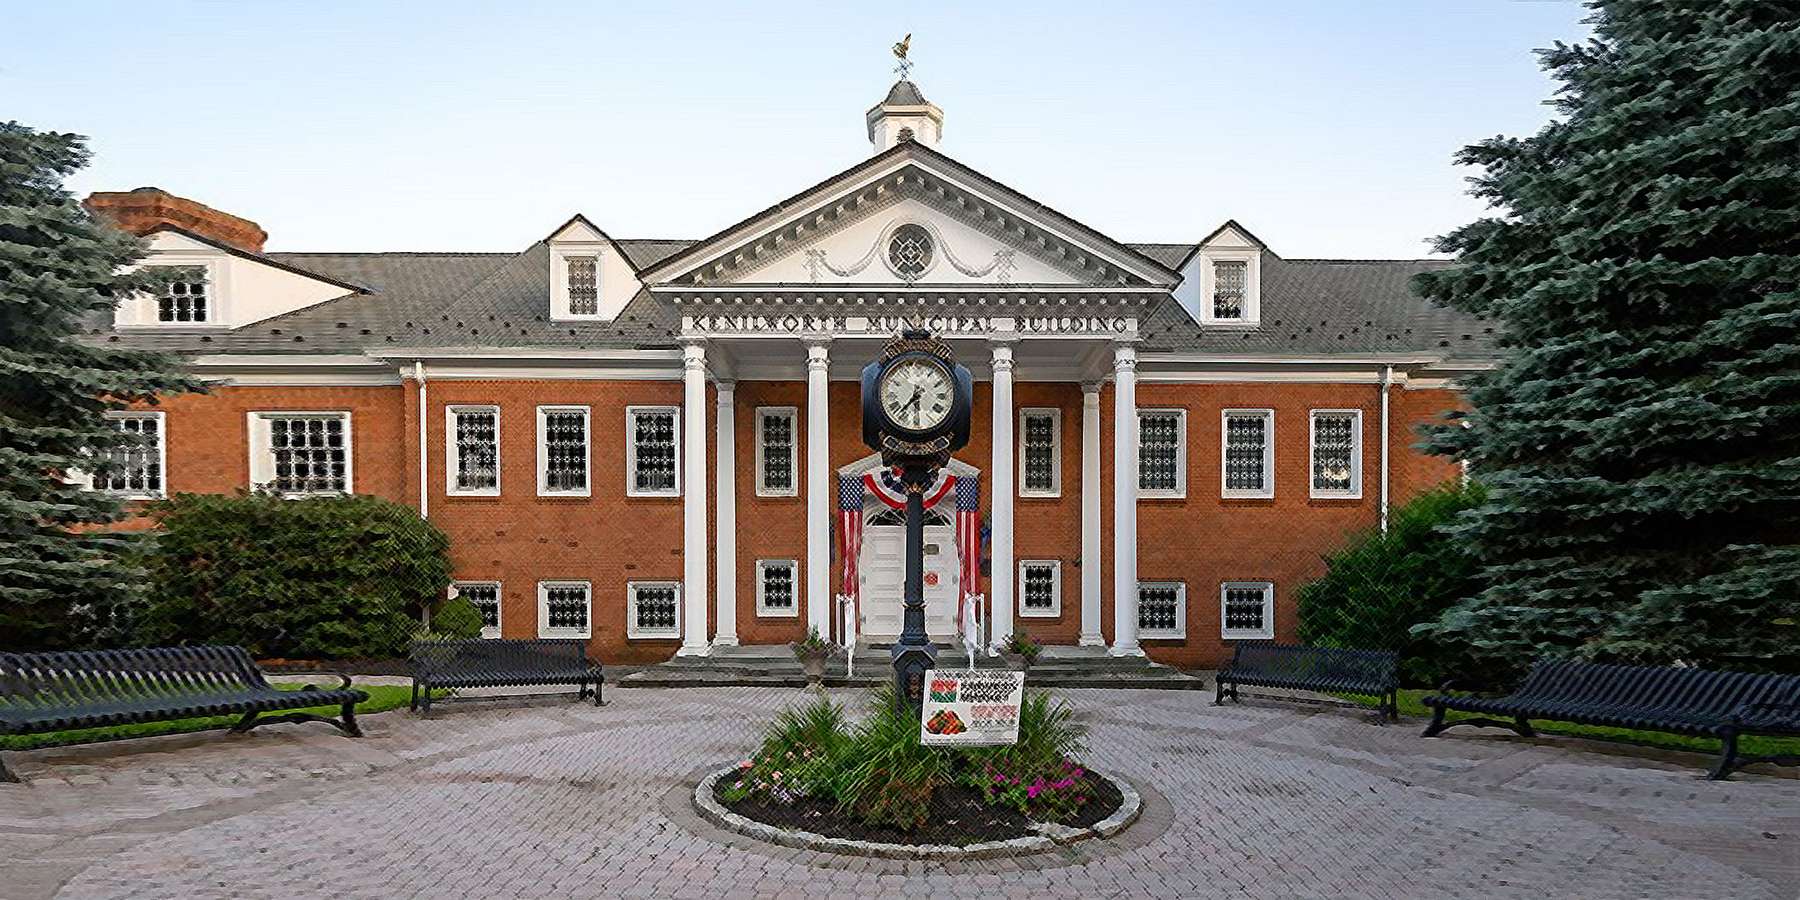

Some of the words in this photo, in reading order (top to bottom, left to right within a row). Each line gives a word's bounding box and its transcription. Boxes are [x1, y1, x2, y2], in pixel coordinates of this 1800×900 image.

[692, 316, 847, 332] KENILWORTH
[867, 316, 997, 332] MUNCIPAL
[1014, 316, 1128, 332] BUILDING
